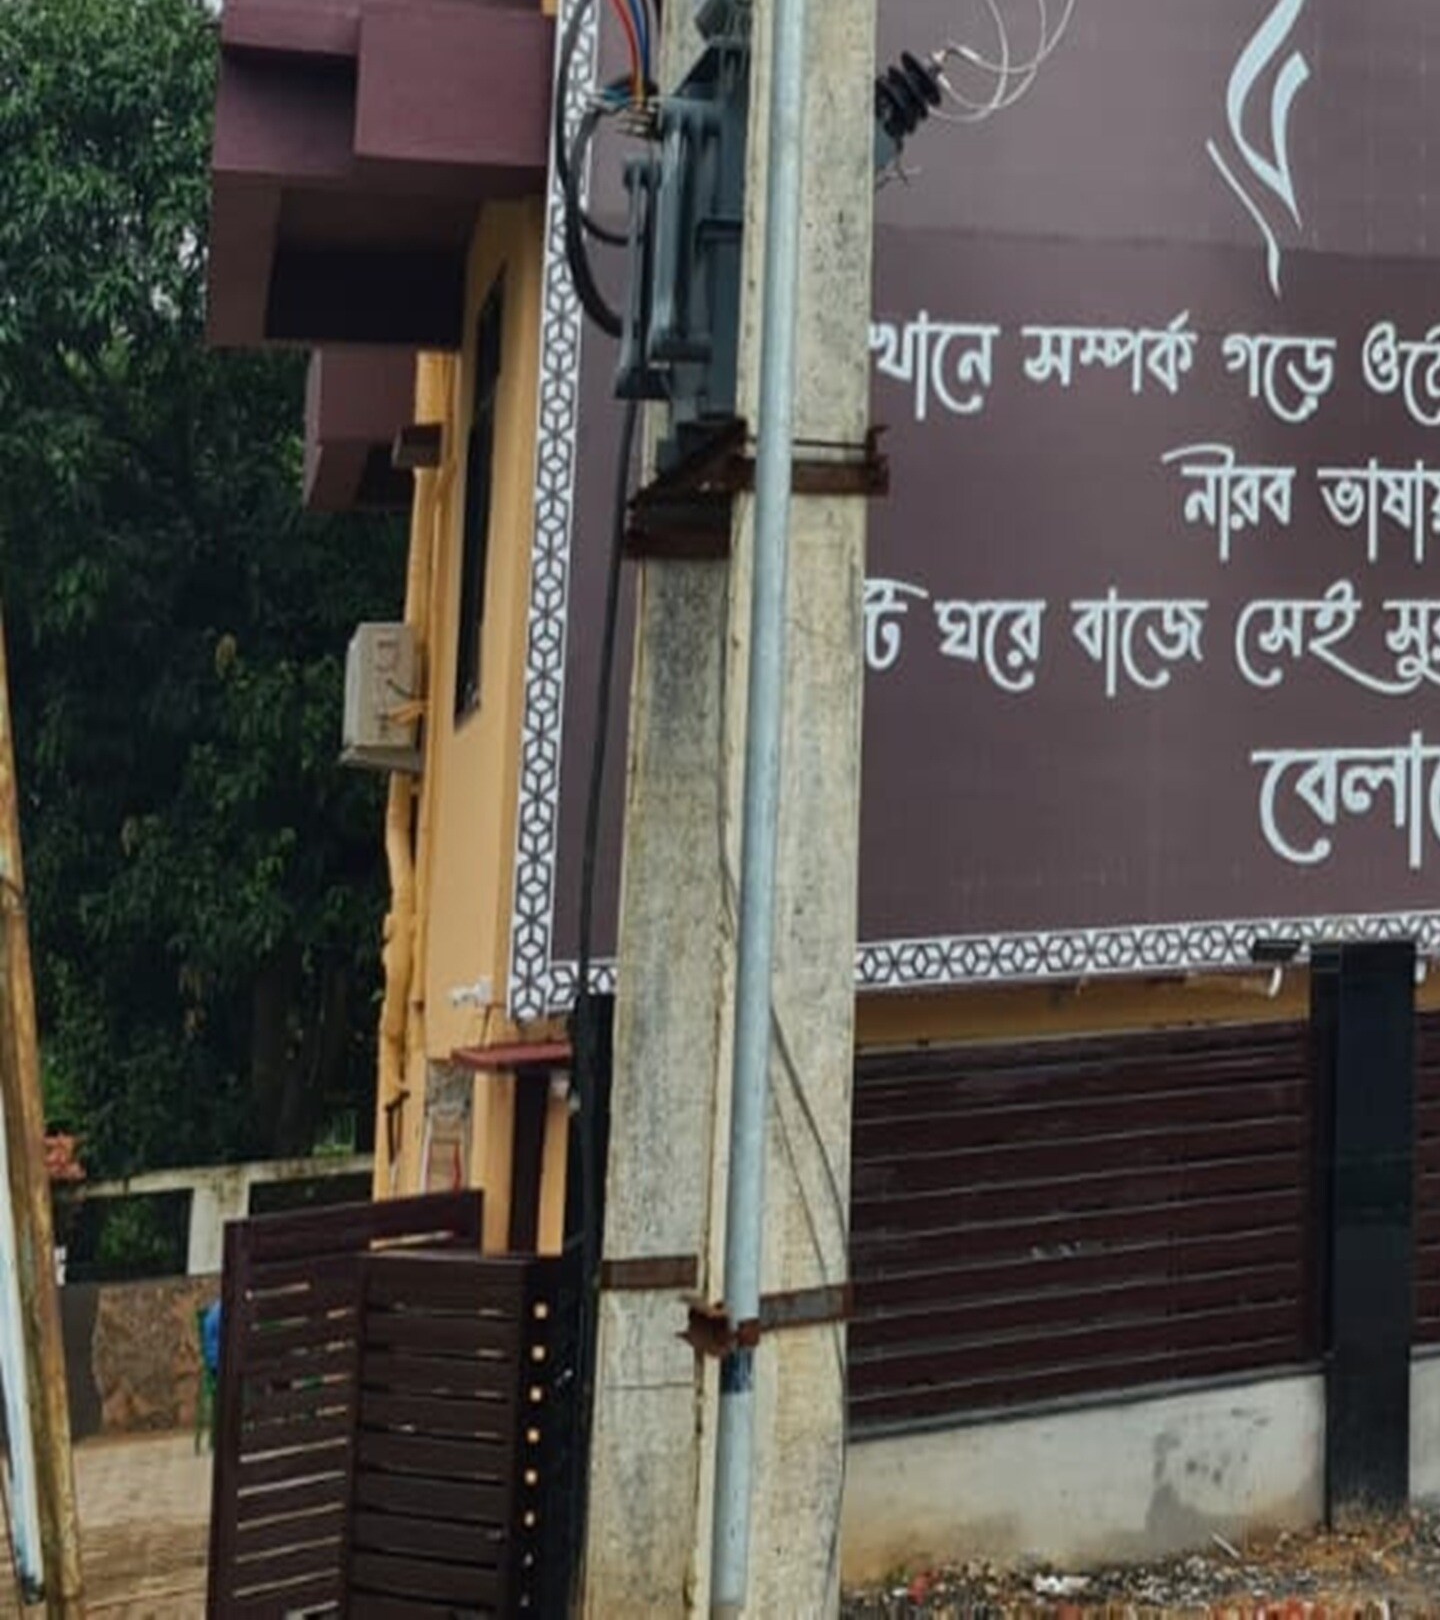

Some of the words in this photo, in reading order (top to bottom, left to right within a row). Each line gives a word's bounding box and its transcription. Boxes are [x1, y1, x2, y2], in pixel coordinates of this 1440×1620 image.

[869, 309, 1000, 420] খানে
[1021, 310, 1198, 394] সম্পর্ক
[1222, 333, 1336, 422] গড়ে
[1161, 443, 1296, 562] নীরব
[933, 599, 1047, 692] ঘরে
[1070, 586, 1209, 697] বাজে
[1235, 579, 1421, 694] সেই
